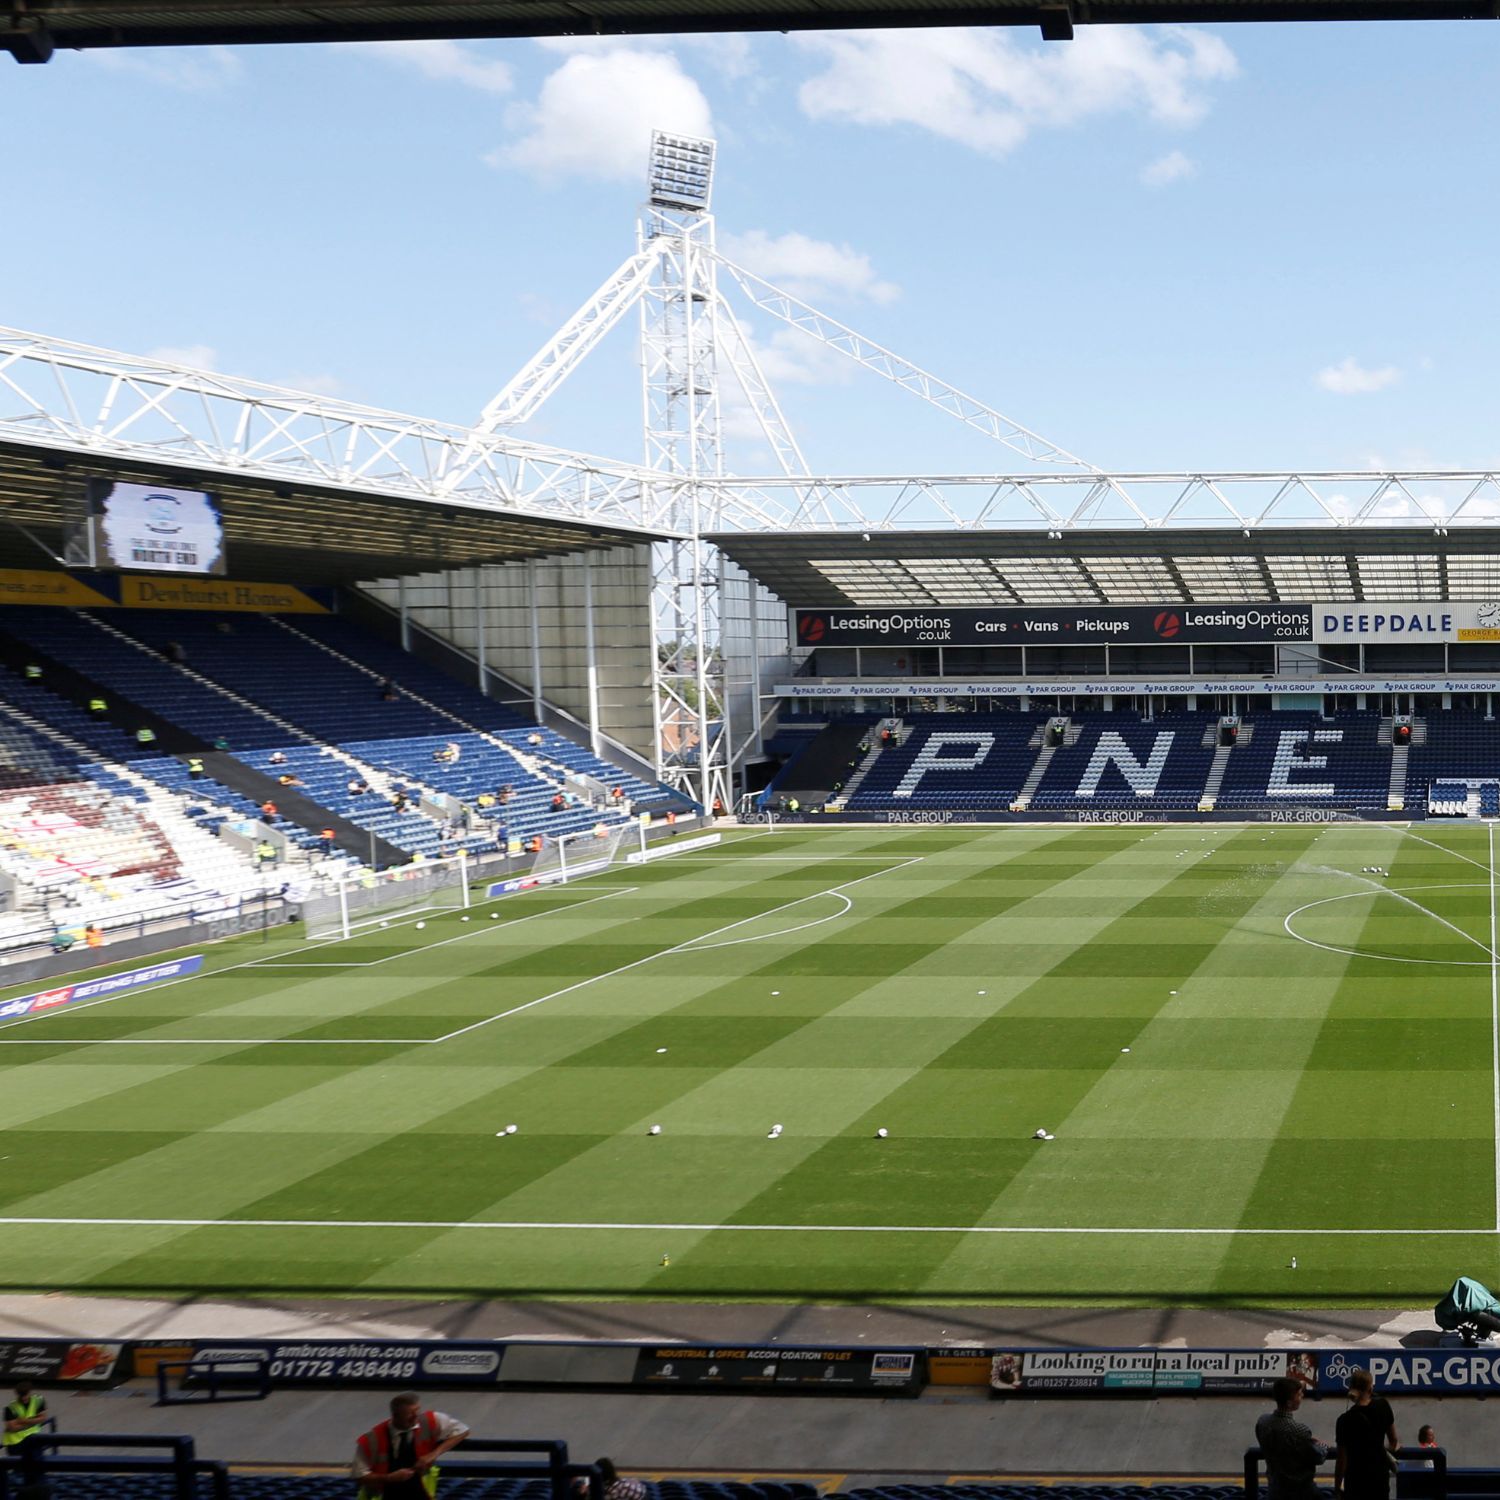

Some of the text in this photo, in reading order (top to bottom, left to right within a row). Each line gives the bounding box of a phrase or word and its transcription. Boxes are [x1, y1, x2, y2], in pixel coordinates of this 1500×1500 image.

[830, 615, 951, 633] LeasingOptions
[974, 620, 1130, 634] Cars Vans Pickups
[1185, 611, 1309, 629] LeasingOptions
[1323, 614, 1452, 632] DEEPDALE
[916, 629, 951, 640] .co.uk
[1273, 625, 1309, 636] .co.uk
[0, 965, 182, 1016] sky bet BETTING BETTER
[274, 1344, 421, 1359] ambrosehire.com
[656, 1350, 707, 1358] INDUSTRIAL
[715, 1350, 747, 1359] OFFICE
[823, 1352, 835, 1360] TO
[836, 1352, 852, 1360] LET
[268, 1360, 417, 1378] 01772 436449
[1030, 1352, 1280, 1375] Looking to run a local pub?
[1027, 1378, 1098, 1387] Call 01257 238814
